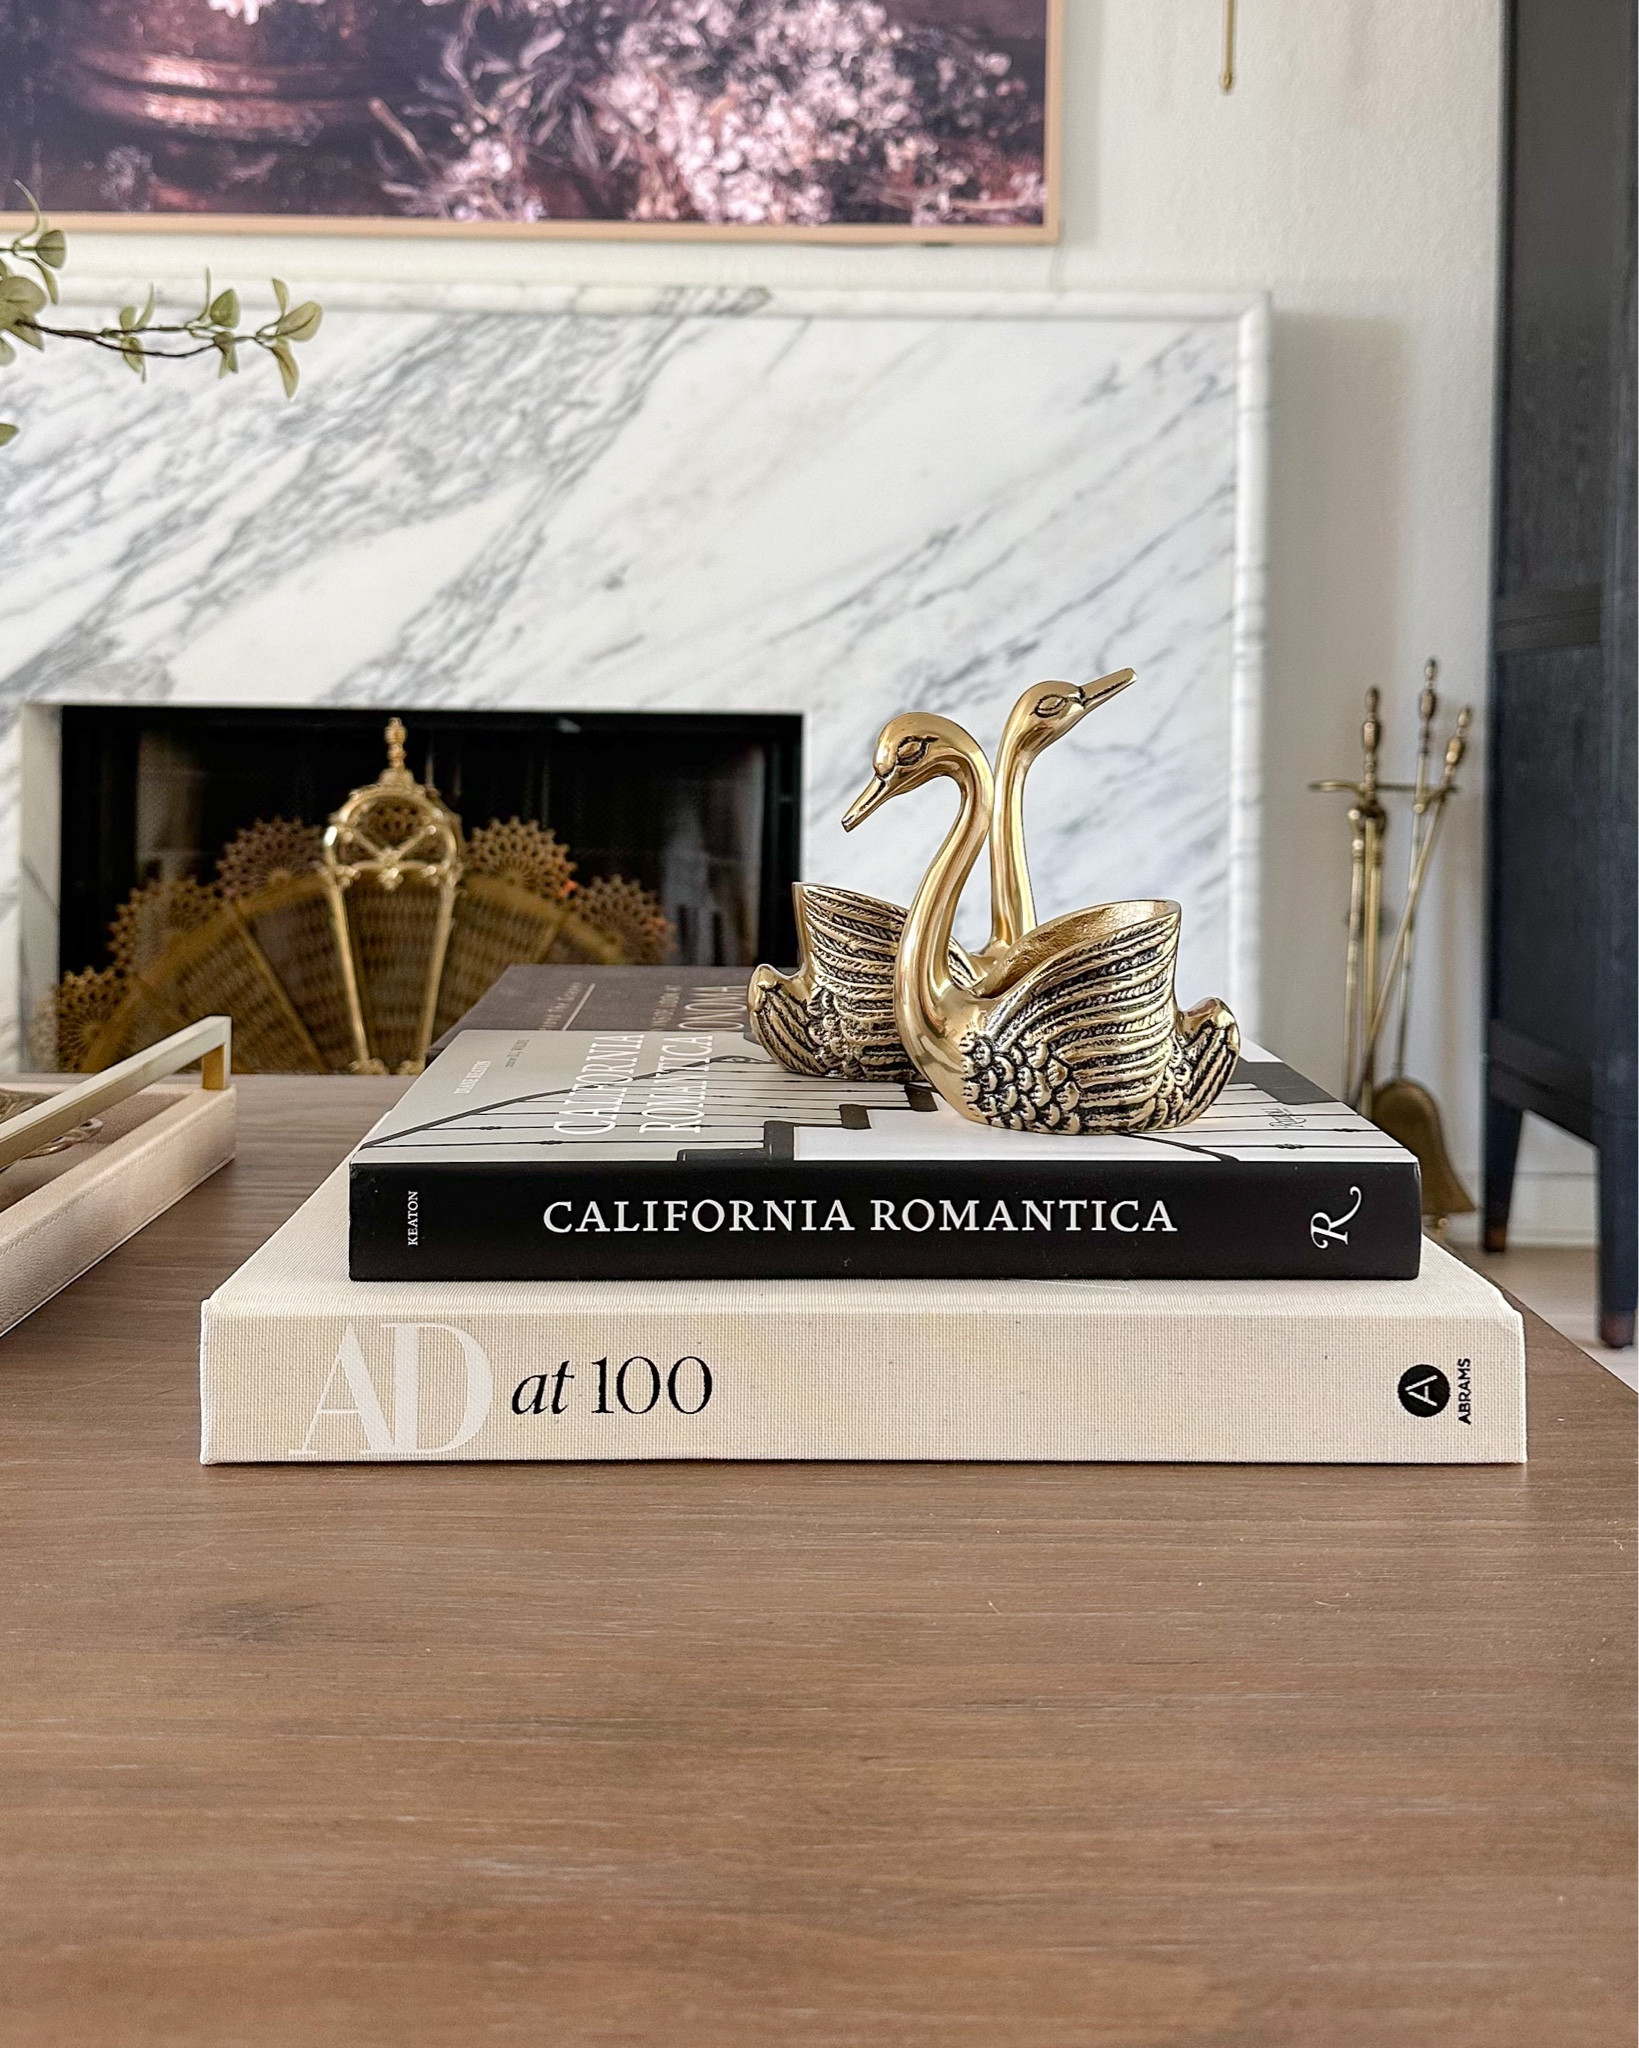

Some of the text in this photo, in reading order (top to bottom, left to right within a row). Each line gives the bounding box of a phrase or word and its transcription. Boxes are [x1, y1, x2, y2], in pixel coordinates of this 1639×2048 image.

[679, 984, 748, 1030] ONOMA
[553, 1034, 645, 1135] CALIFORNIA
[638, 1035, 713, 1133] ROMANTICA
[408, 1191, 418, 1245] KEATON
[544, 1199, 1177, 1232] CALIFORNIA ROMANTICA
[1311, 1186, 1361, 1248] R
[288, 1320, 712, 1456] AD at 100
[1458, 1359, 1471, 1425] ABRAMS
